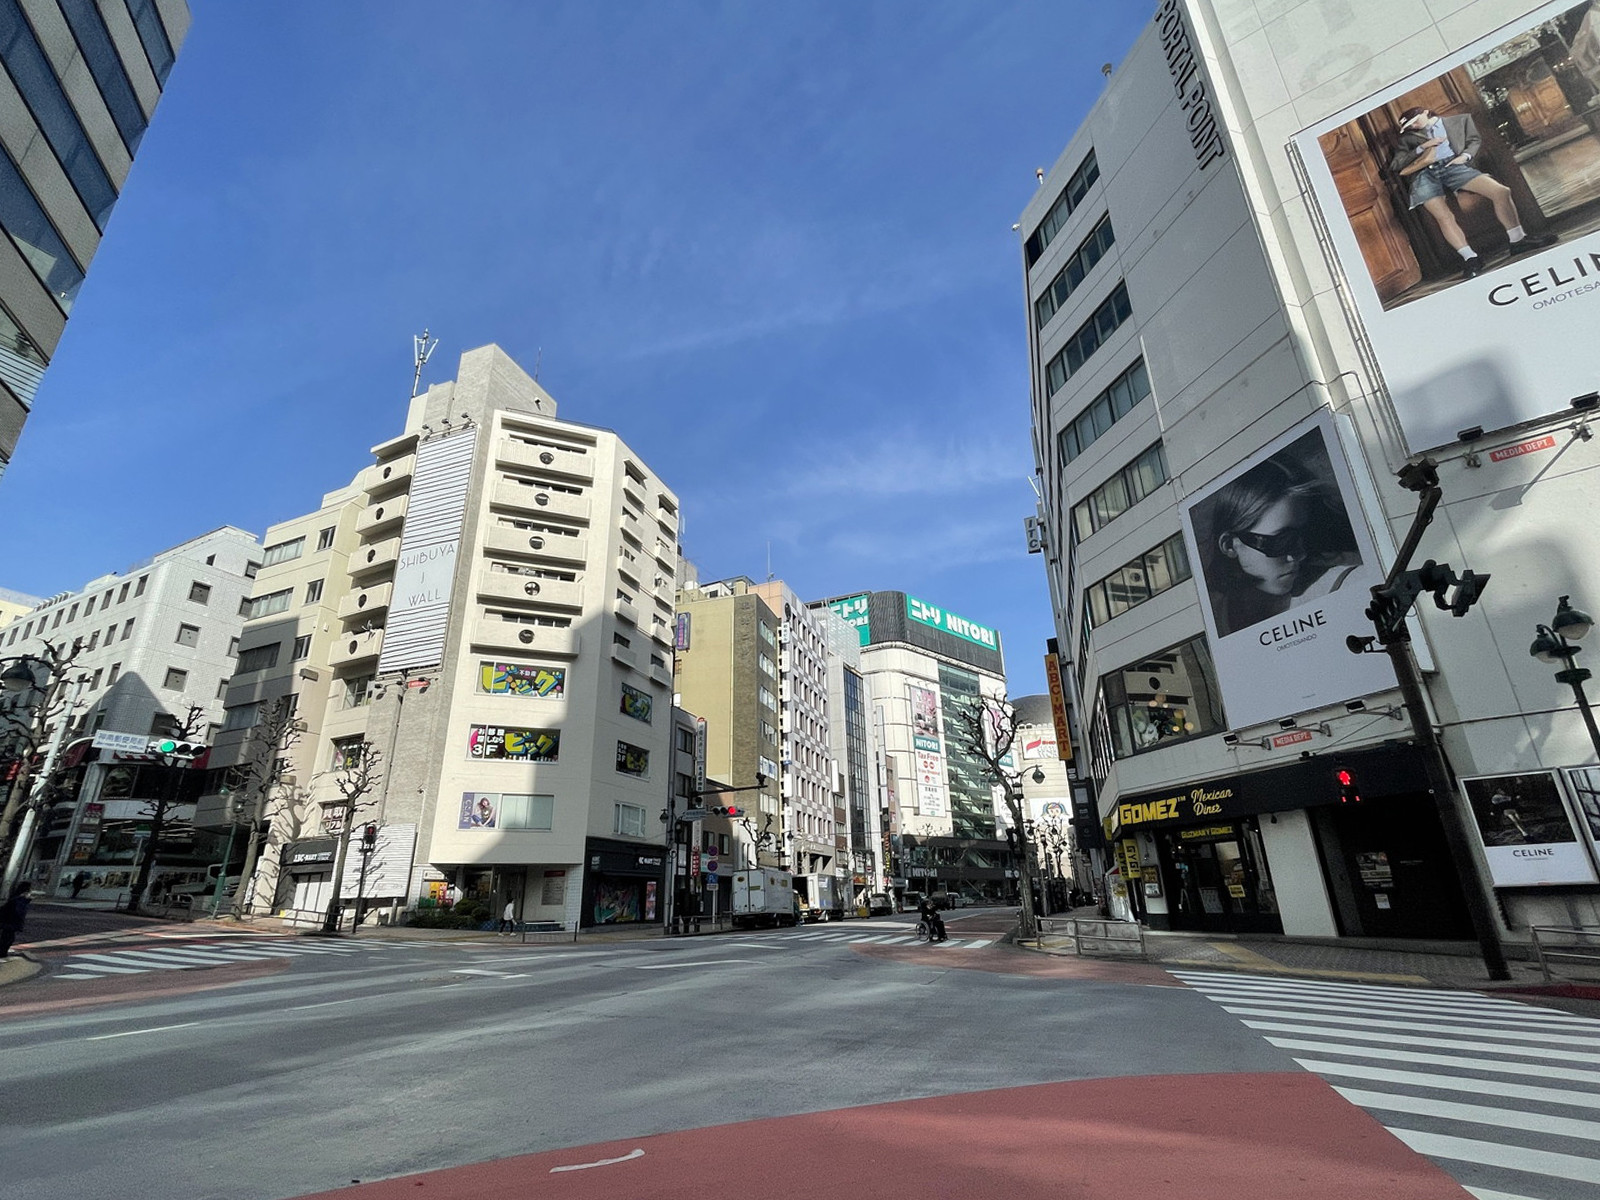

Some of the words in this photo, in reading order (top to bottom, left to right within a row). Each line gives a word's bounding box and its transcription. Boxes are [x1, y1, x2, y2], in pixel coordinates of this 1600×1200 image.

[1155, 0, 1197, 99] PORTAL
[1181, 81, 1224, 170] POINT
[1495, 446, 1525, 459] MEDIA
[1525, 439, 1552, 452] DEPT.
[1028, 519, 1039, 548] ITC
[400, 543, 455, 570] SHIBUYA
[408, 588, 441, 607] WALL
[911, 598, 941, 625] ニトリ
[946, 612, 995, 646] NITORI
[1259, 609, 1327, 646] CELINE
[482, 665, 562, 697] ビッグ
[1048, 661, 1068, 752] ABC-MART
[472, 744, 499, 756] 3F
[504, 731, 557, 755] ビッグ
[915, 738, 939, 751] NITORI
[1191, 788, 1233, 804] Mexican
[1193, 802, 1222, 816] Diner
[1119, 798, 1179, 825] GOMEZ
[1126, 845, 1140, 873] GYG!
[1513, 848, 1554, 857] CELINE
